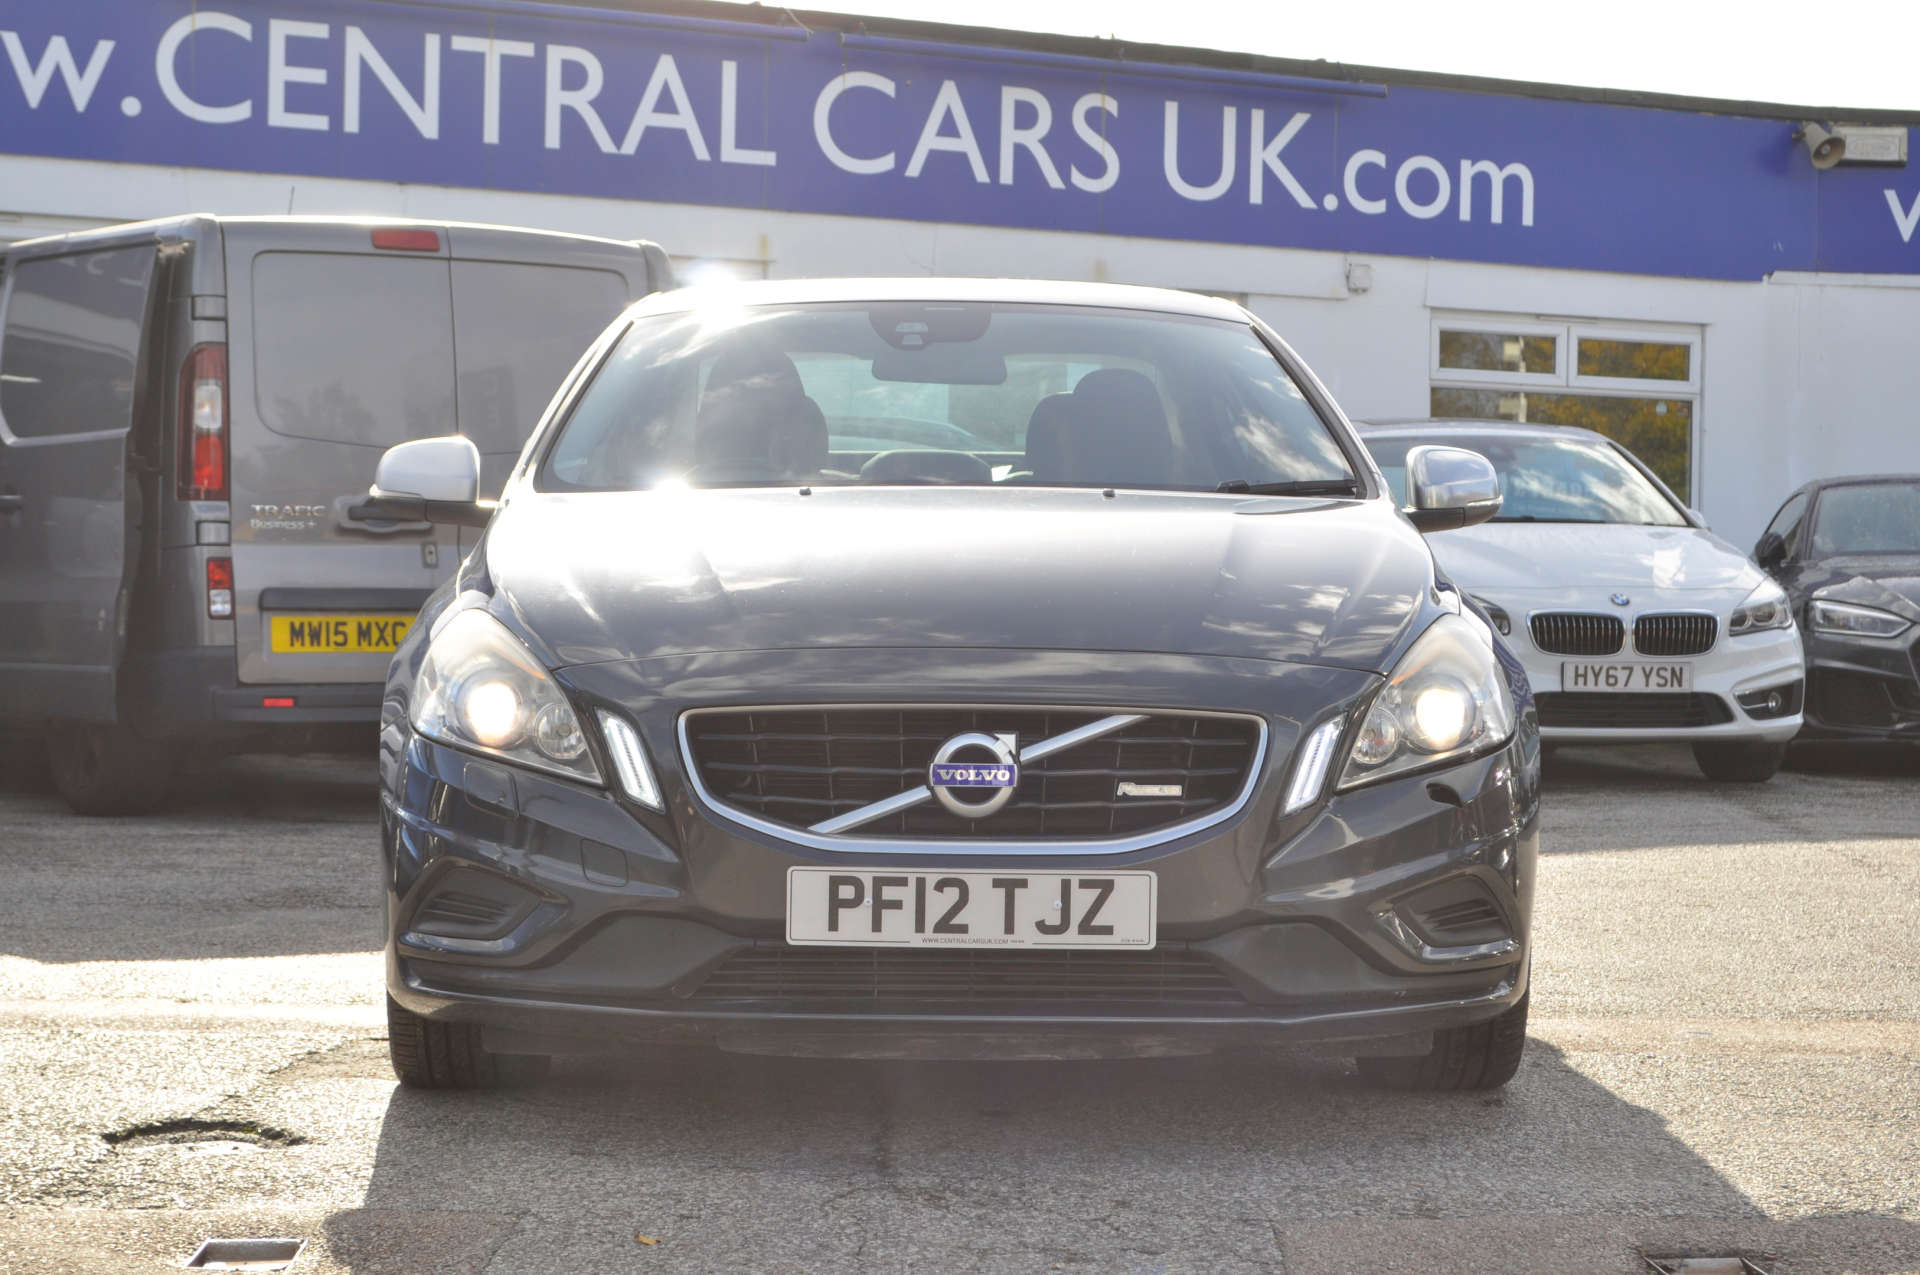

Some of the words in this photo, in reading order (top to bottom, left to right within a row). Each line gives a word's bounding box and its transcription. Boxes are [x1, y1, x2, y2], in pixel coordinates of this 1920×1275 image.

[813, 70, 1120, 193] CARS
[1163, 100, 1535, 227] UK.com
[289, 620, 348, 648] MW15
[356, 620, 407, 647] MXC
[1573, 664, 1635, 688] HY67
[1640, 665, 1684, 689] YSN
[936, 768, 1010, 781] VOLVO
[827, 874, 970, 935] PF12
[991, 877, 1115, 936] TJZ
